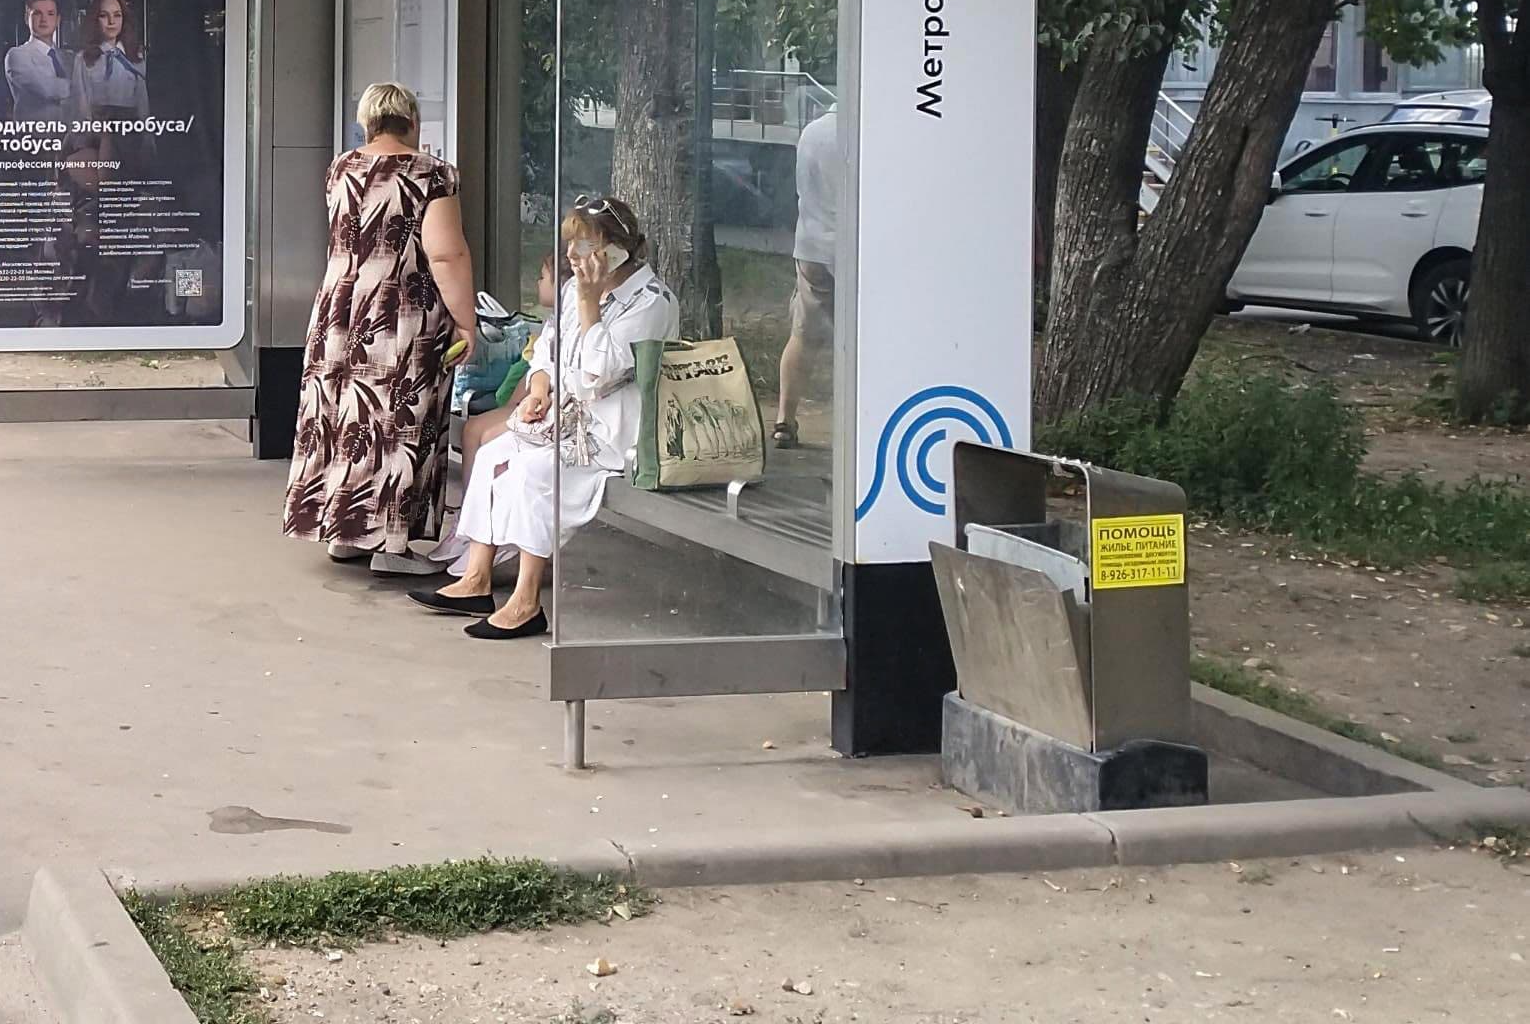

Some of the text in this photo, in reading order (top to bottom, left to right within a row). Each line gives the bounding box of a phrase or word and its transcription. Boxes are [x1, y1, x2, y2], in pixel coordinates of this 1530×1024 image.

[71, 115, 194, 136] электробуса/
[0, 159, 52, 171] профессия
[55, 160, 85, 170] нужна
[87, 160, 121, 170] городу
[1099, 526, 1176, 540] ПОМОЩЬ
[1135, 540, 1176, 551] ПИТАНИЕ
[1101, 566, 1176, 581] 8-926-317-11-11
